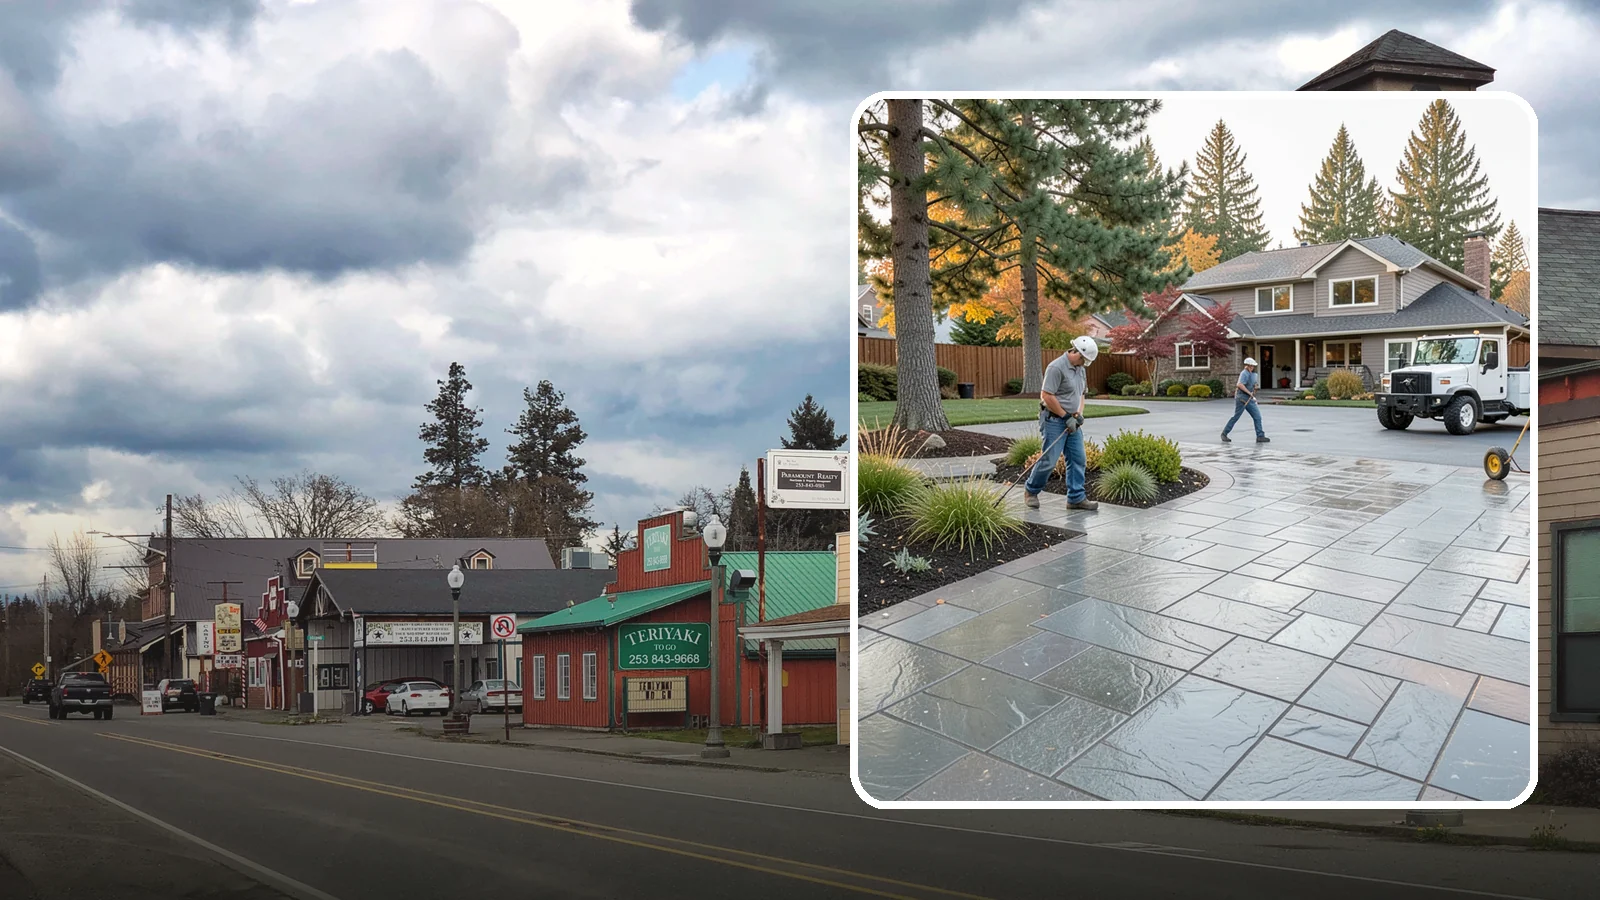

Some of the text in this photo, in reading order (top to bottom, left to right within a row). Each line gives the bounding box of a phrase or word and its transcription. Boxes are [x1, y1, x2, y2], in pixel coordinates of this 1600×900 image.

[781, 471, 839, 480] PARAMOUNT REALTY
[624, 627, 702, 646] TERIYAKI
[628, 653, 700, 665] 253 843-9668
[639, 681, 672, 690] TERIYAKI
